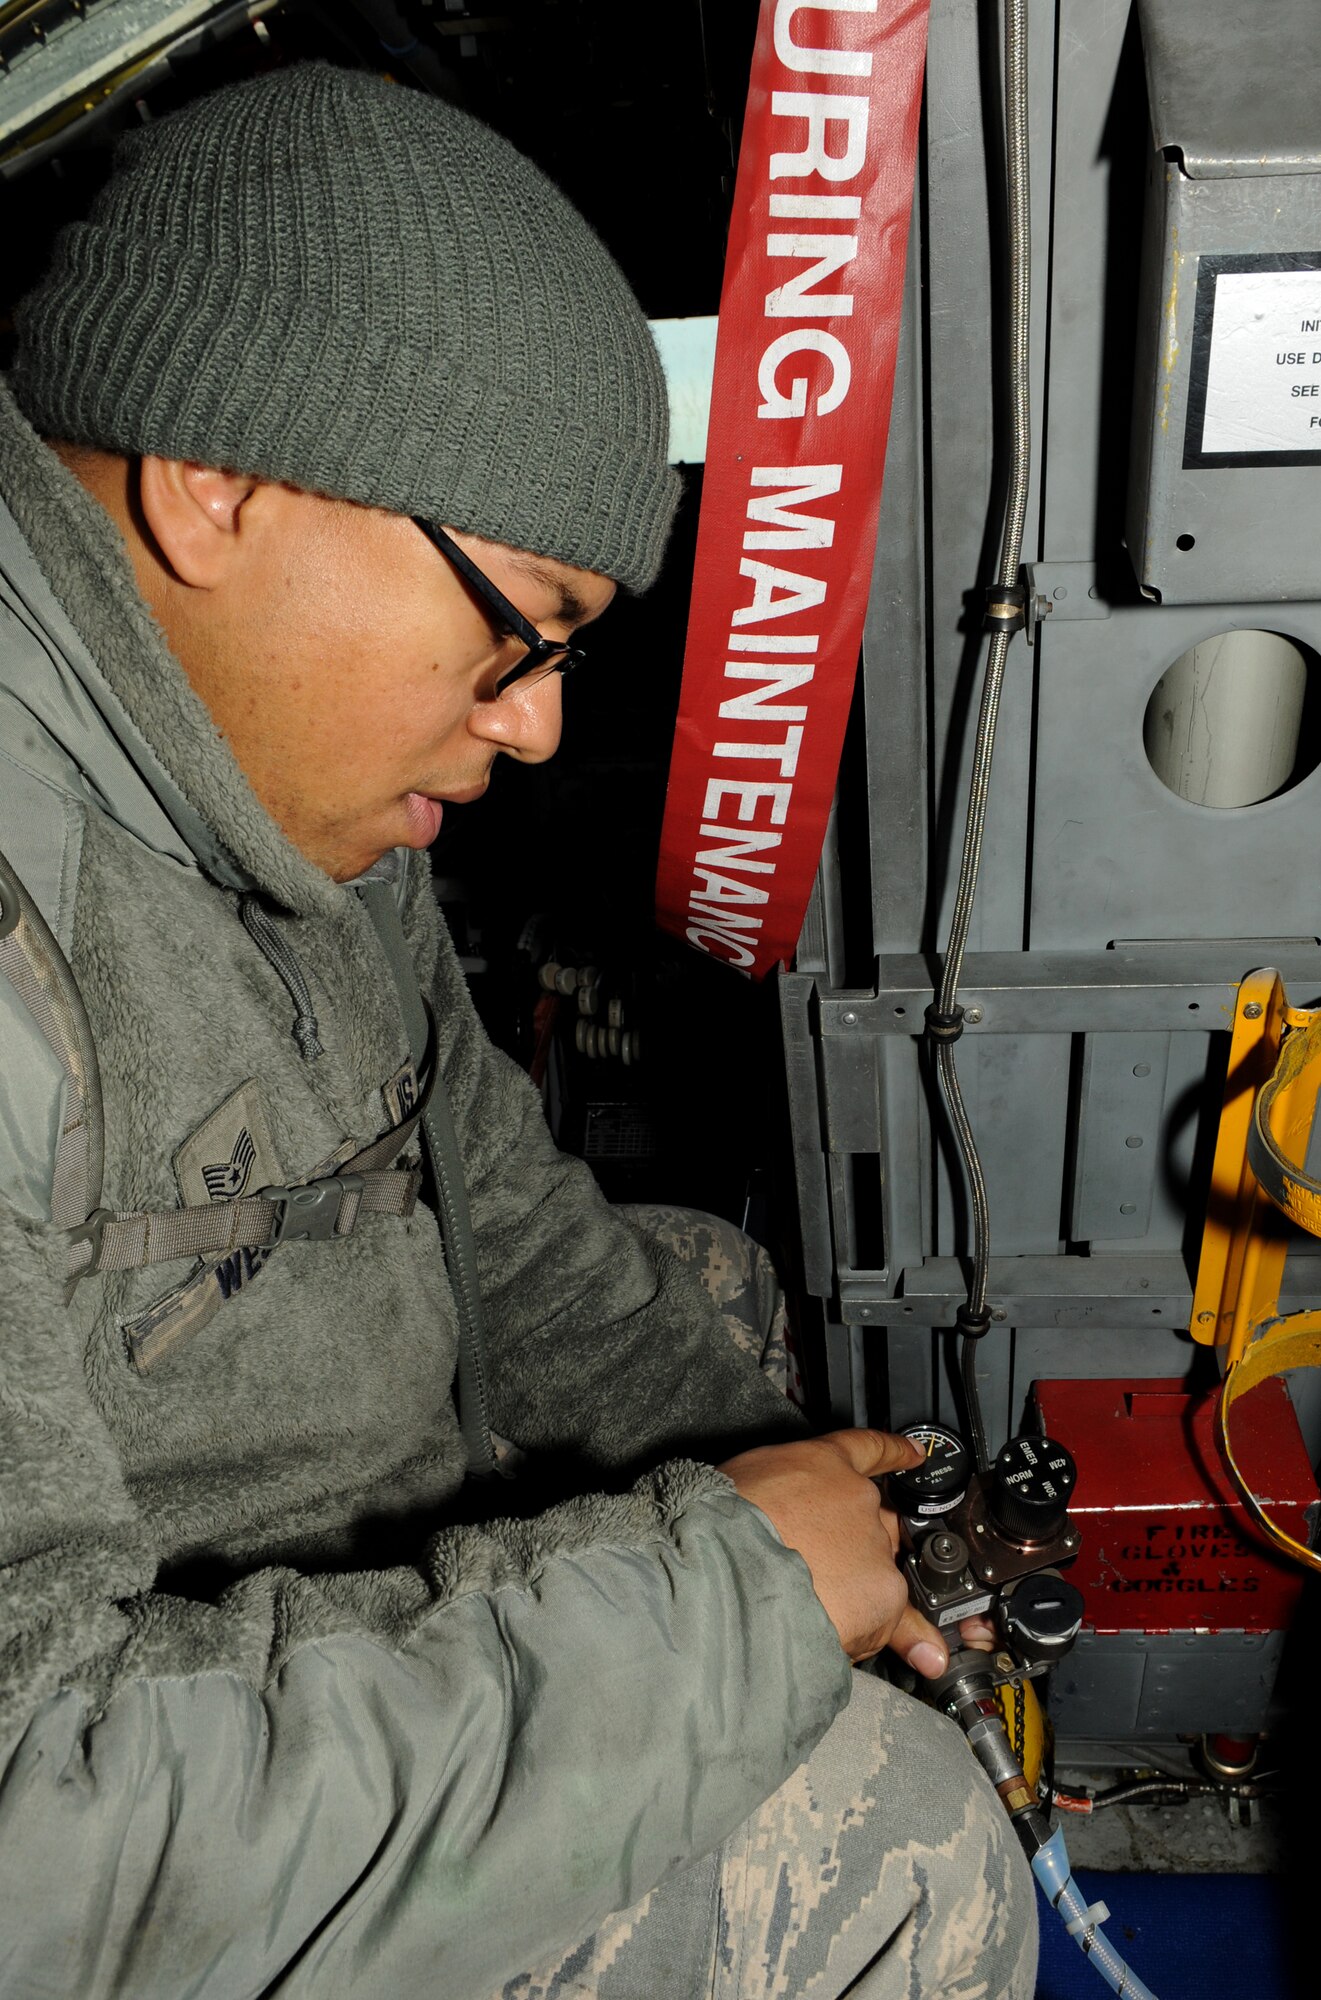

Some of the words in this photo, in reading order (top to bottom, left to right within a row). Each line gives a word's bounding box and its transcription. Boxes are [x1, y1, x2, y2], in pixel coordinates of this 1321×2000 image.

[1301, 320, 1321, 332] INI
[1276, 353, 1306, 365] USE
[1291, 385, 1320, 397] SEE
[686, 464, 843, 979] MAINTENANC
[215, 1247, 272, 1299] WE
[1019, 1441, 1038, 1465] EMER
[1048, 1458, 1066, 1470] 42M
[1006, 1469, 1034, 1485] NORM
[1042, 1480, 1057, 1498] 30M
[1146, 1524, 1233, 1541] FIRE
[1122, 1544, 1249, 1560] GLOVES
[1111, 1577, 1260, 1593] GOGGLES
